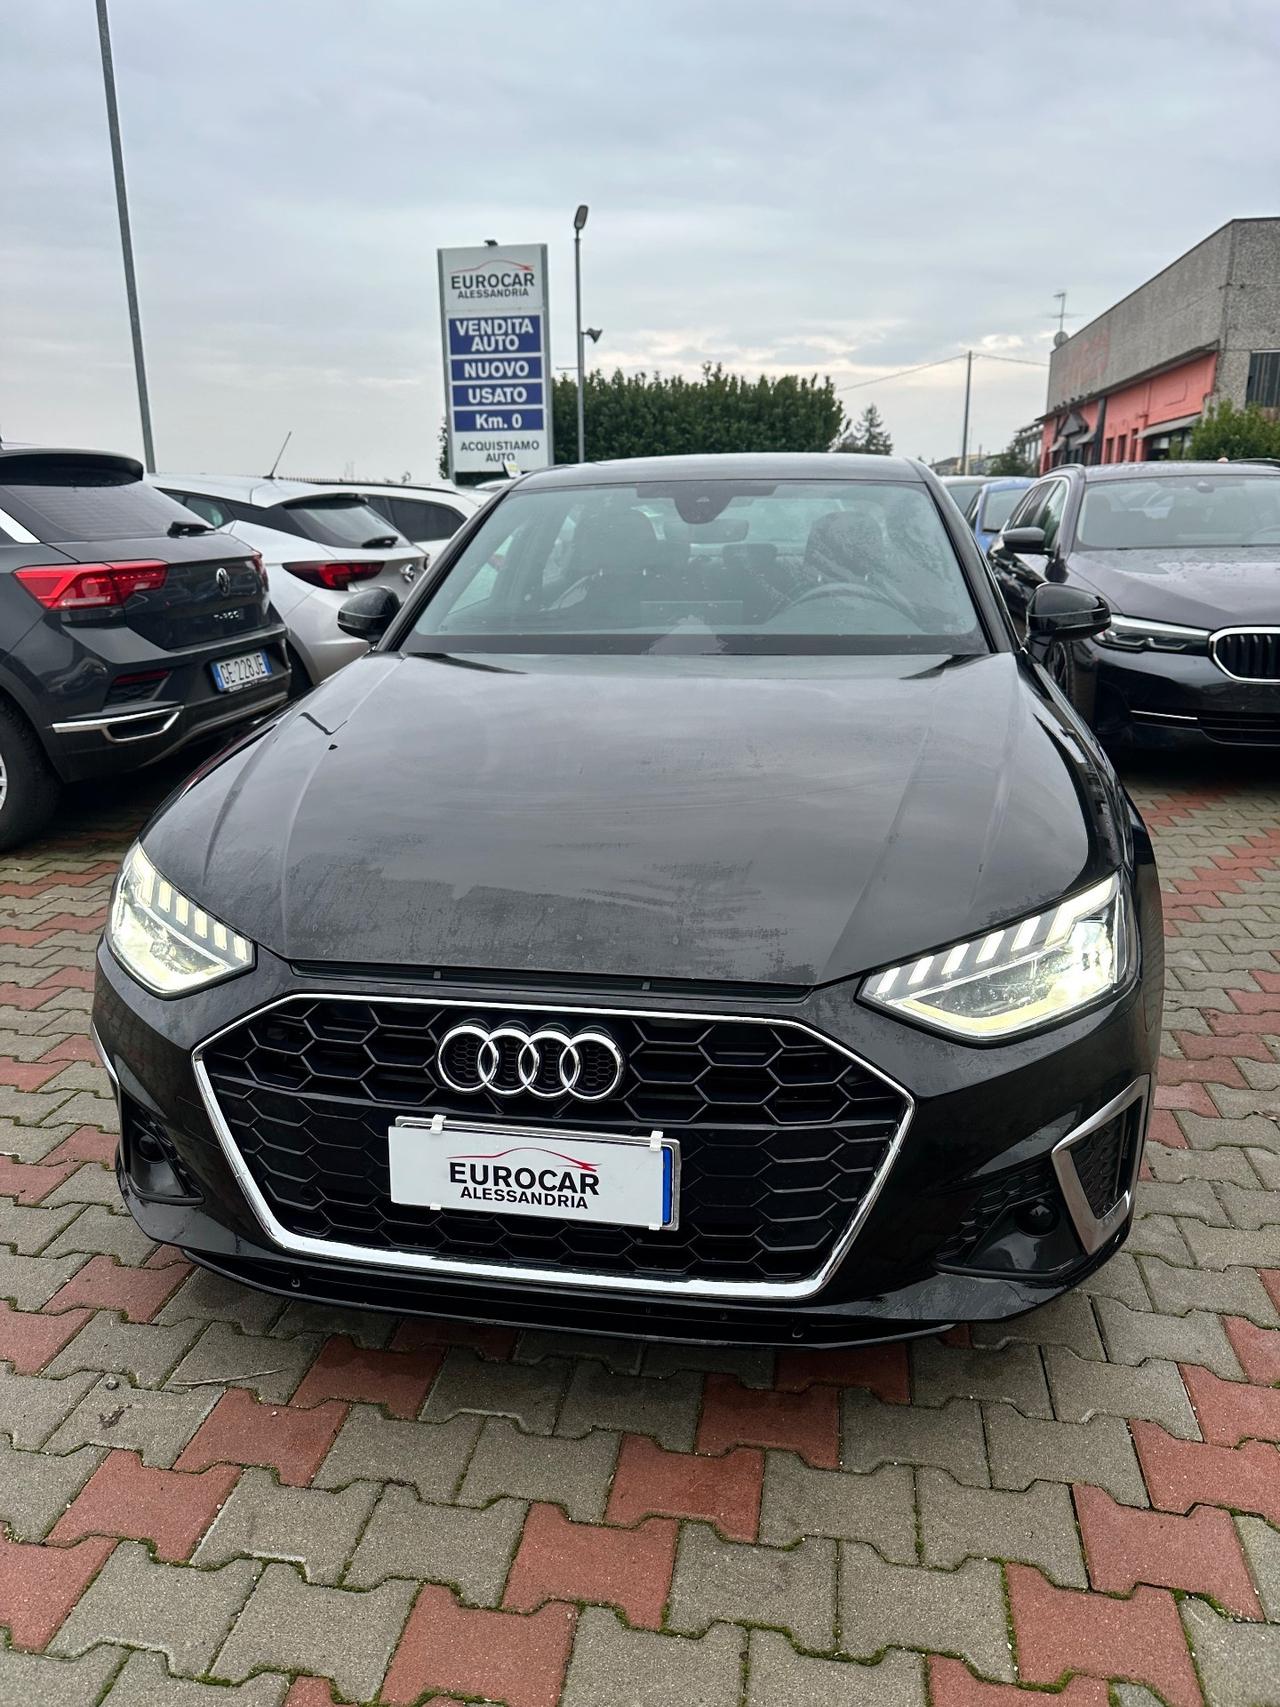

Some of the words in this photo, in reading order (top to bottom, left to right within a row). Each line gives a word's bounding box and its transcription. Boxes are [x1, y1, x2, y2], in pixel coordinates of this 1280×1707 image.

[451, 272, 535, 290] EUROCAR
[457, 287, 529, 299] ALESSANDRIA
[455, 318, 533, 336] VENDITA
[471, 335, 519, 352] AUTO
[464, 361, 529, 378] NUOVO
[468, 387, 527, 404] USATO
[475, 414, 508, 429] Km.
[512, 413, 522, 428] 0
[460, 440, 539, 452] ACQUISTIAMO
[485, 452, 515, 463] AUTO
[449, 1161, 600, 1196] EUROCAR
[460, 1185, 589, 1209] ALESSANDRIA
